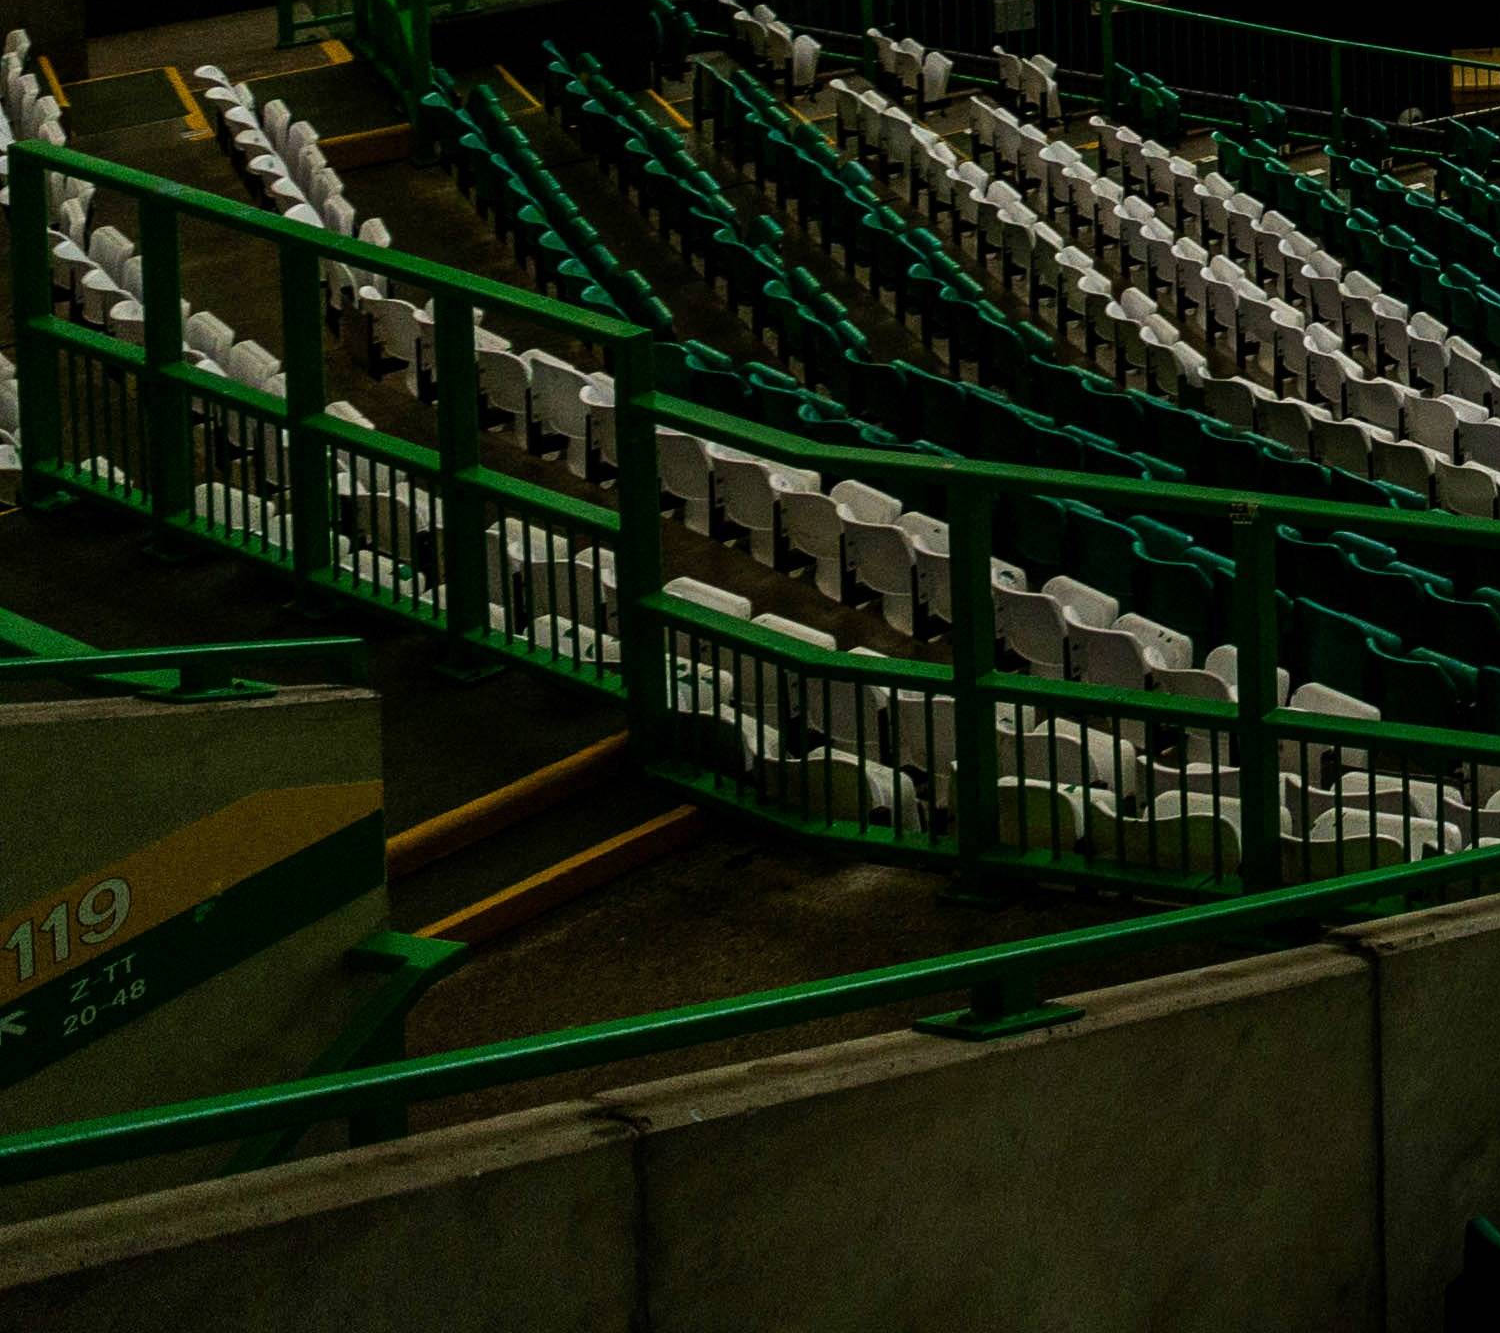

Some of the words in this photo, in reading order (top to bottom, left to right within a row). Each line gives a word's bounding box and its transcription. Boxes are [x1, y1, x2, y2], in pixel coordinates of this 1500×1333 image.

[3, 877, 131, 981] 119
[63, 978, 146, 1036] 20-48
[70, 952, 137, 1004] Z-TT
